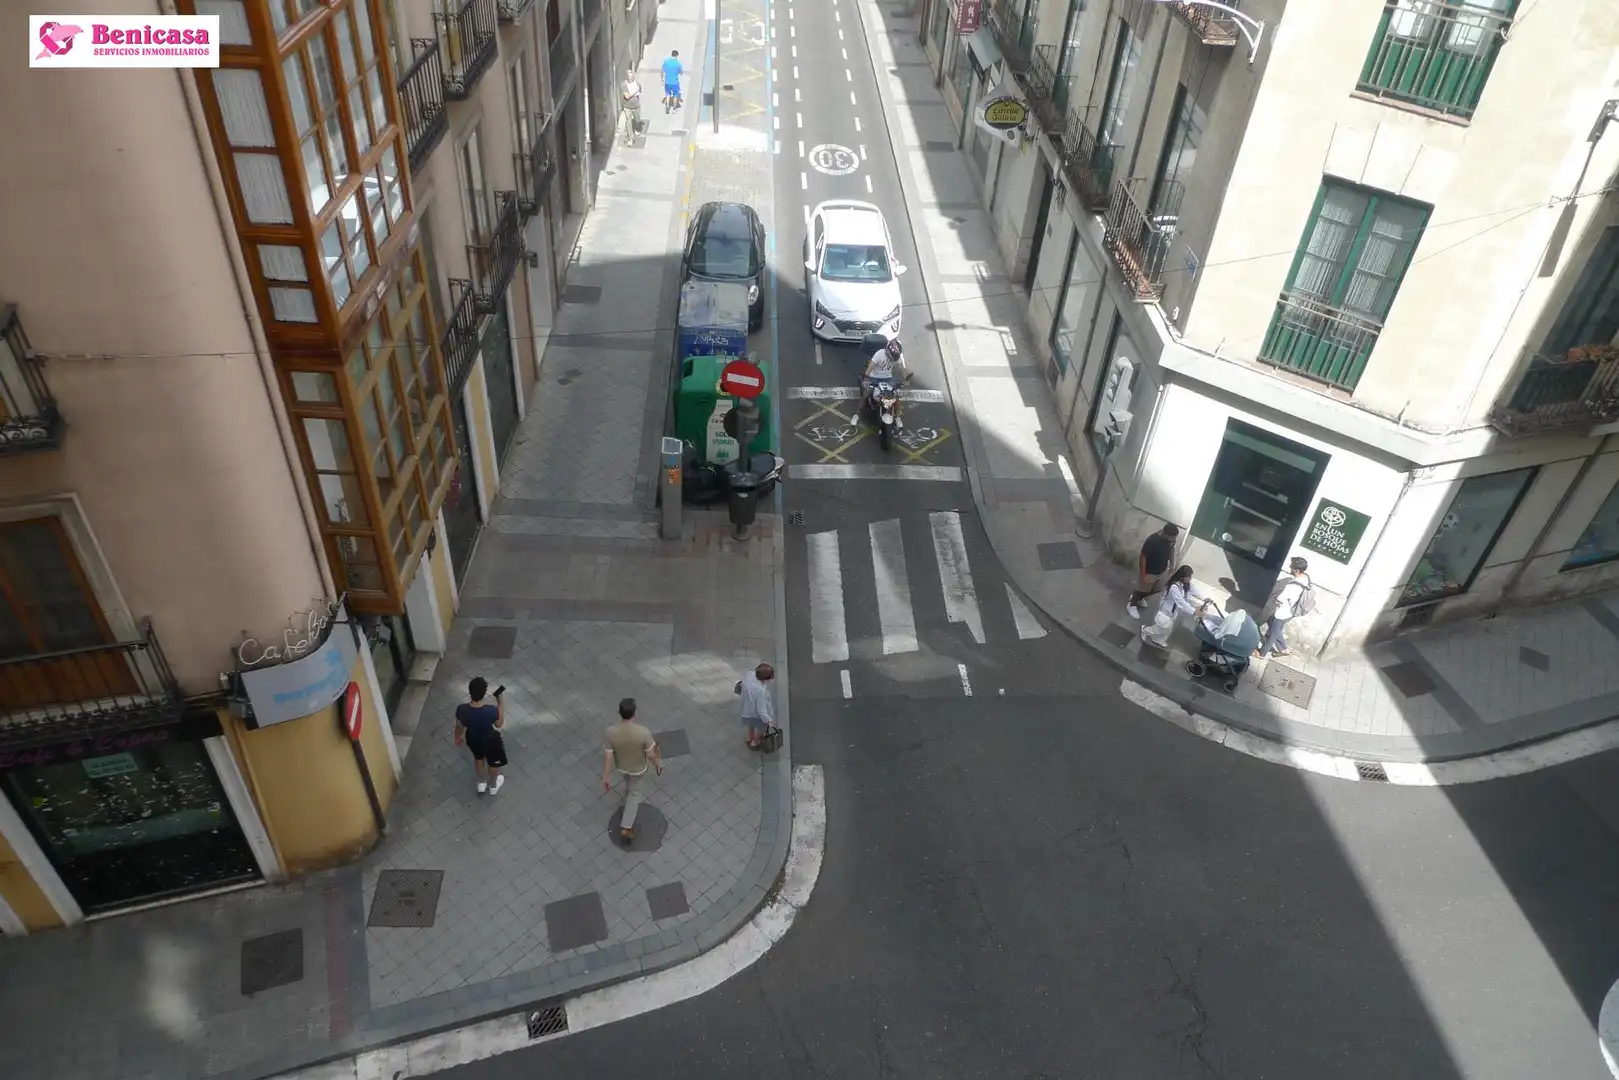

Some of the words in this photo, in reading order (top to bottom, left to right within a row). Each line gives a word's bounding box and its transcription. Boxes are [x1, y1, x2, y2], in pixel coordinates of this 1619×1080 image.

[1313, 528, 1347, 546] BOSQUE
[1315, 522, 1328, 532] EN
[1331, 528, 1345, 538] UN
[1310, 533, 1322, 543] DE
[1323, 538, 1350, 554] HOJAS
